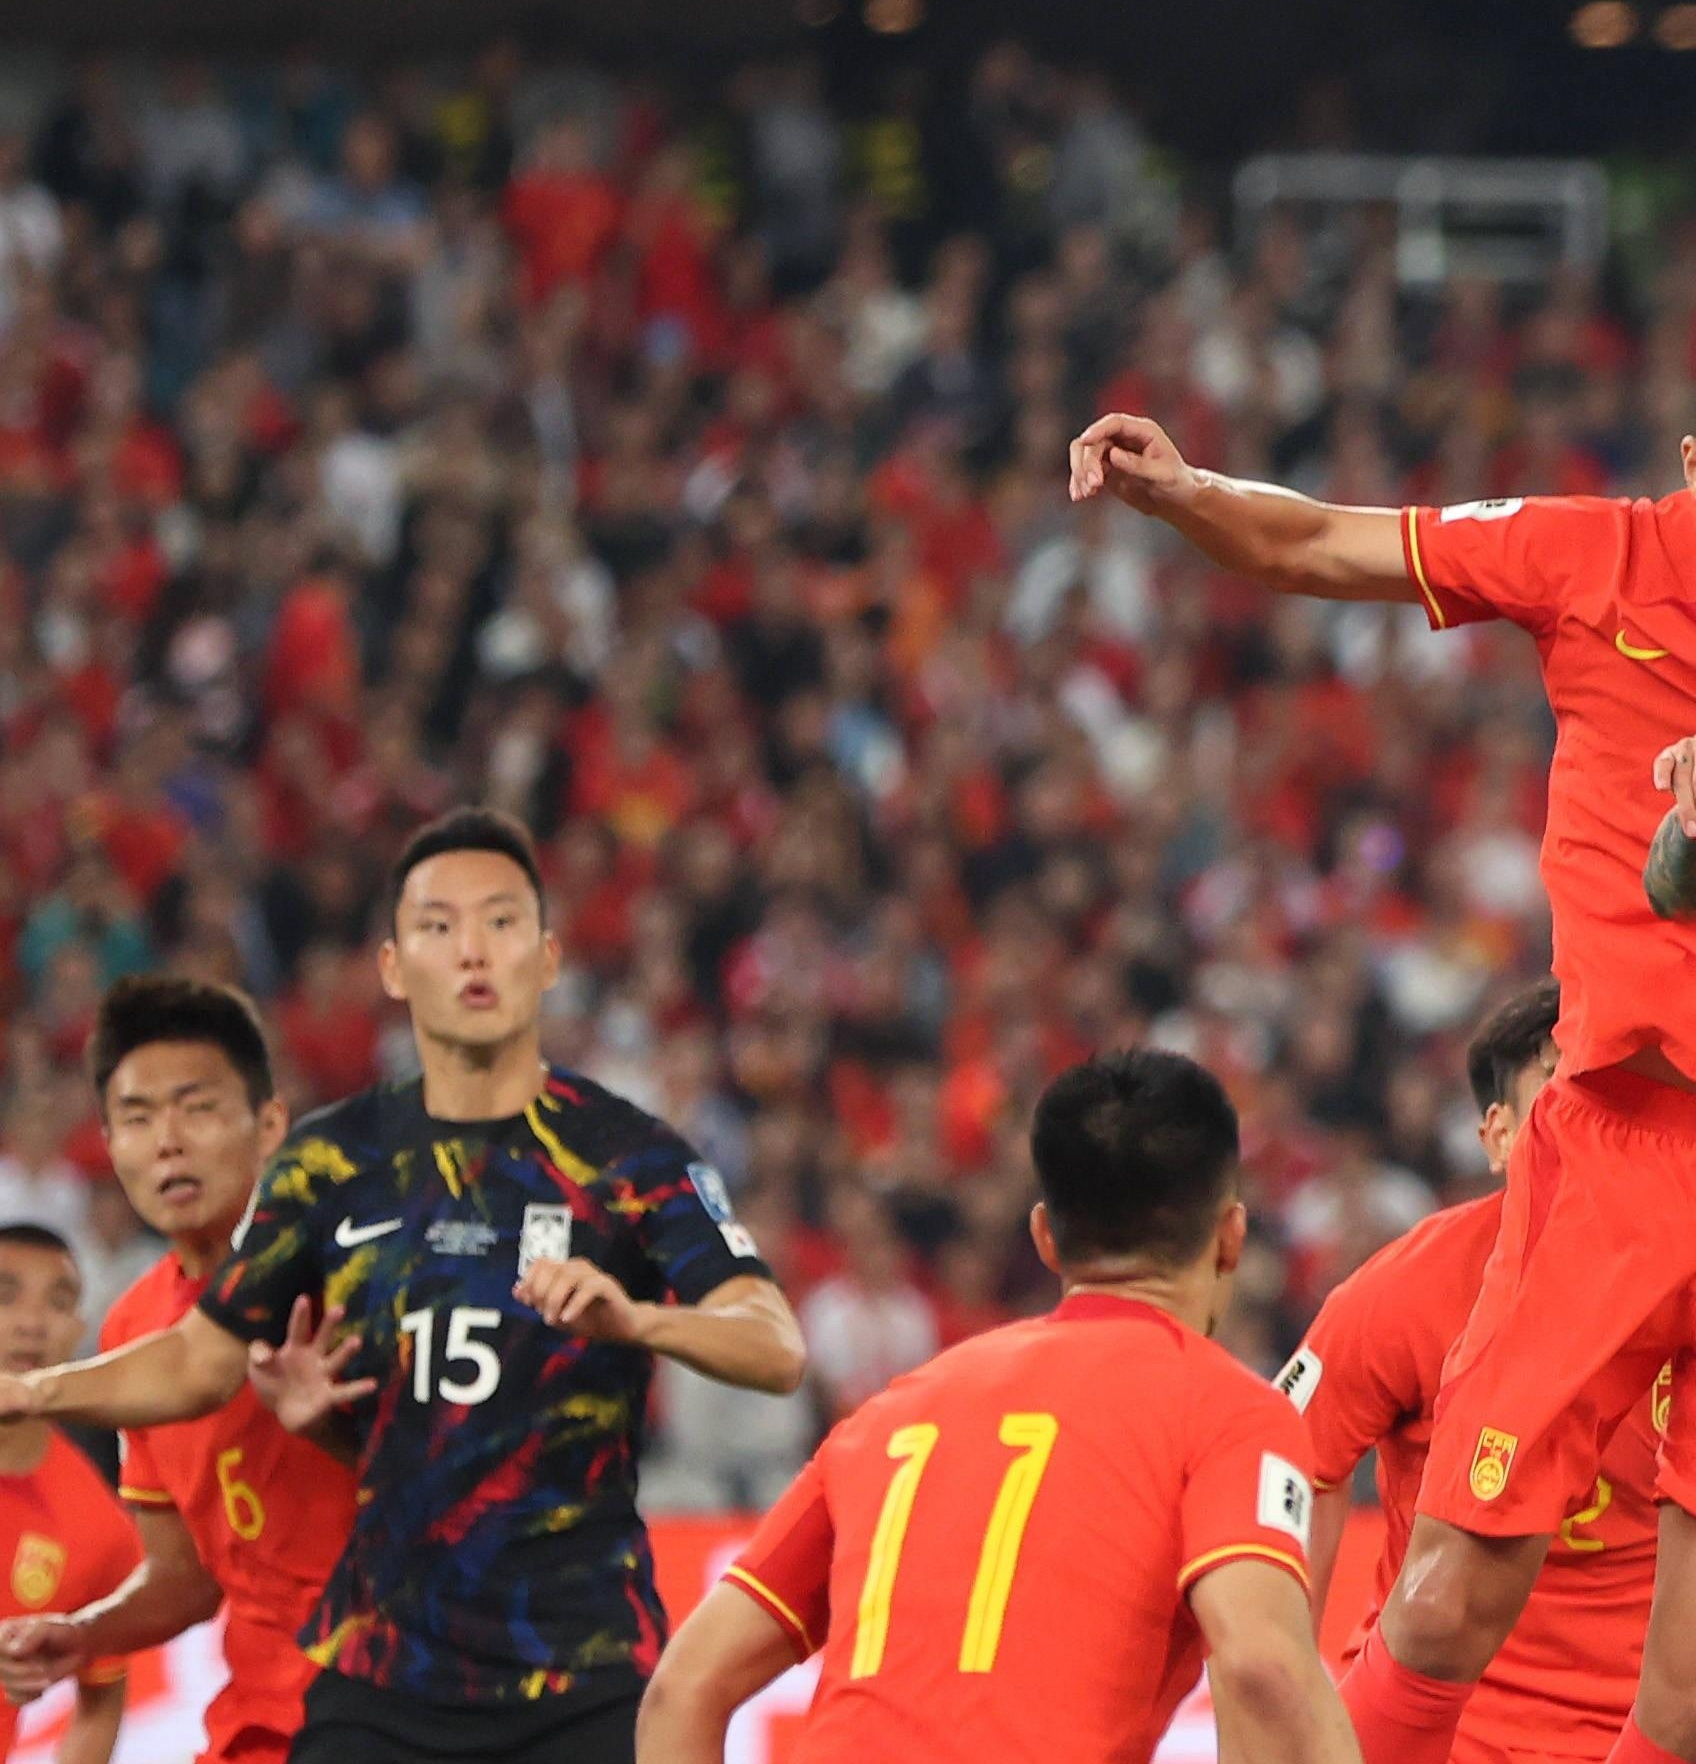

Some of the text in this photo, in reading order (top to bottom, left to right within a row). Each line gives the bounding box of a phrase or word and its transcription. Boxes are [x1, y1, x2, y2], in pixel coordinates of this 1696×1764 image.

[399, 1306, 502, 1406] 15
[217, 1448, 265, 1540] 6
[851, 1412, 1058, 1679] 11
